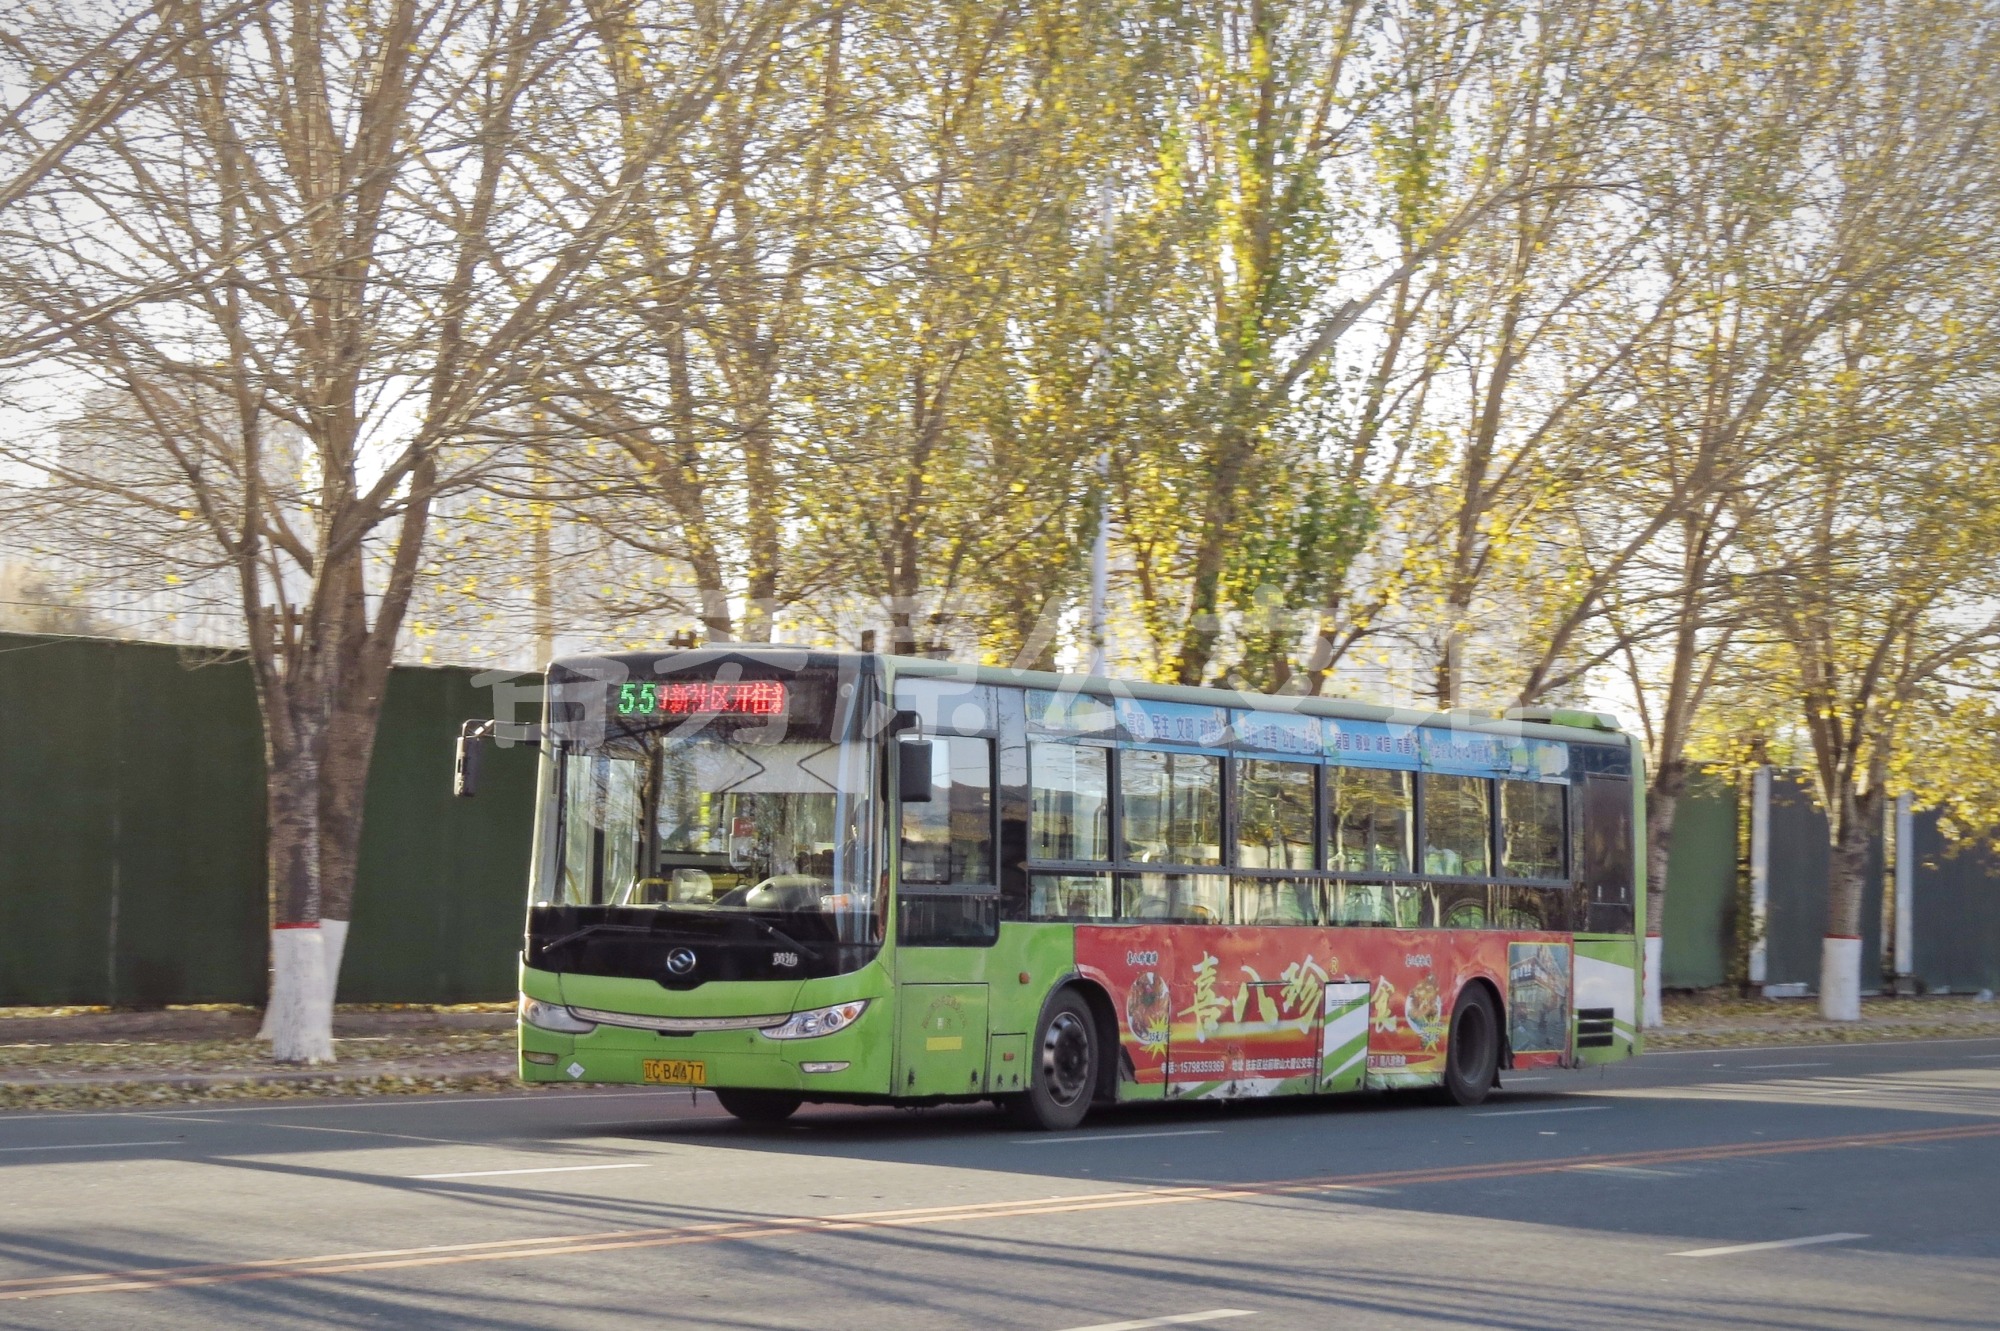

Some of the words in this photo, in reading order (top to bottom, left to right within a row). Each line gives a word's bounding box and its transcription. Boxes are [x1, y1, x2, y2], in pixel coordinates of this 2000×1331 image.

[618, 683, 656, 714] 55
[1151, 713, 1170, 738] 民主
[1175, 716, 1194, 740] 文明
[1263, 724, 1278, 748] 平等
[1283, 726, 1297, 749] 公正
[1334, 732, 1350, 750] 爱国
[1376, 735, 1391, 753] 诚信
[772, 952, 798, 967] 黄海
